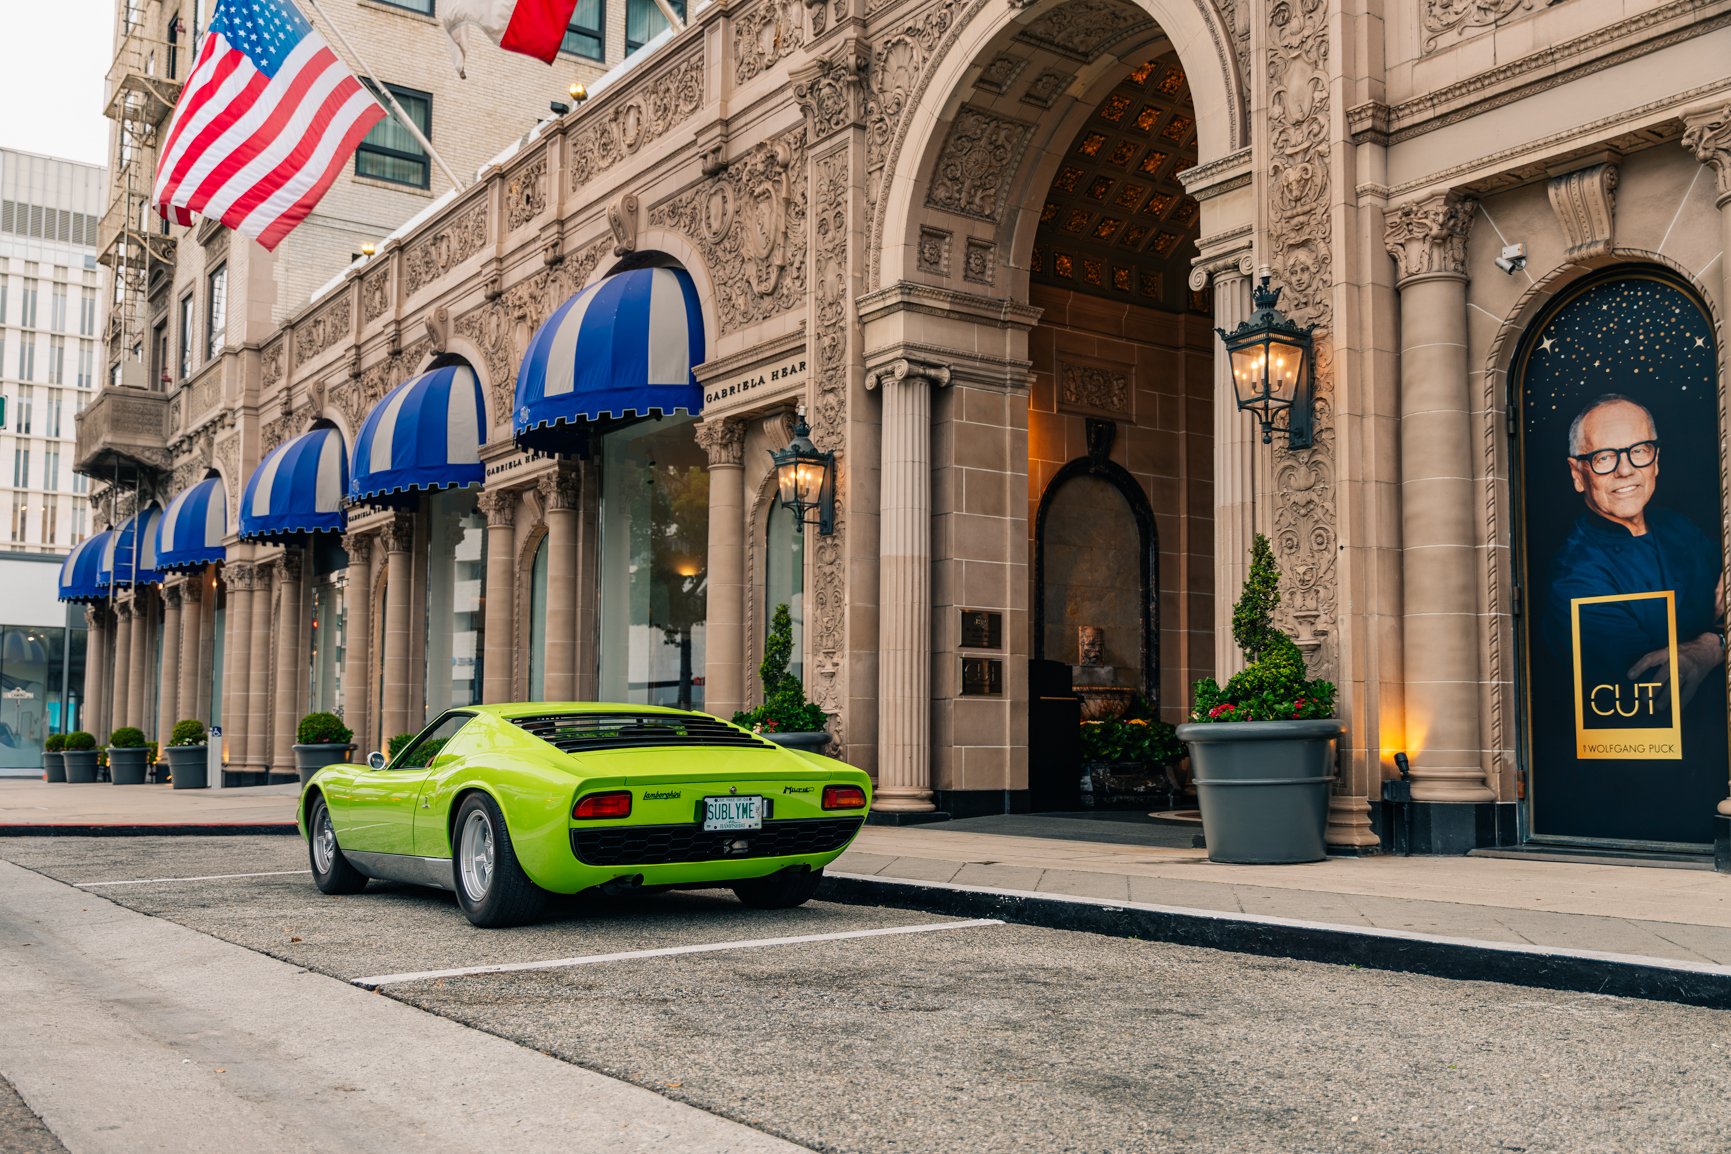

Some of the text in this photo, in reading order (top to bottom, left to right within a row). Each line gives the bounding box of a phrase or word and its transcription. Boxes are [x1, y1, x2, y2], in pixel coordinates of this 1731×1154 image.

[705, 361, 806, 404] GABRIELA HEAR
[486, 458, 523, 477] GABRIELA
[1590, 682, 1662, 717] CUT
[1588, 744, 1646, 754] WOLFGANG
[1649, 744, 1675, 753] PUCK
[707, 802, 755, 820] SUBLYME
